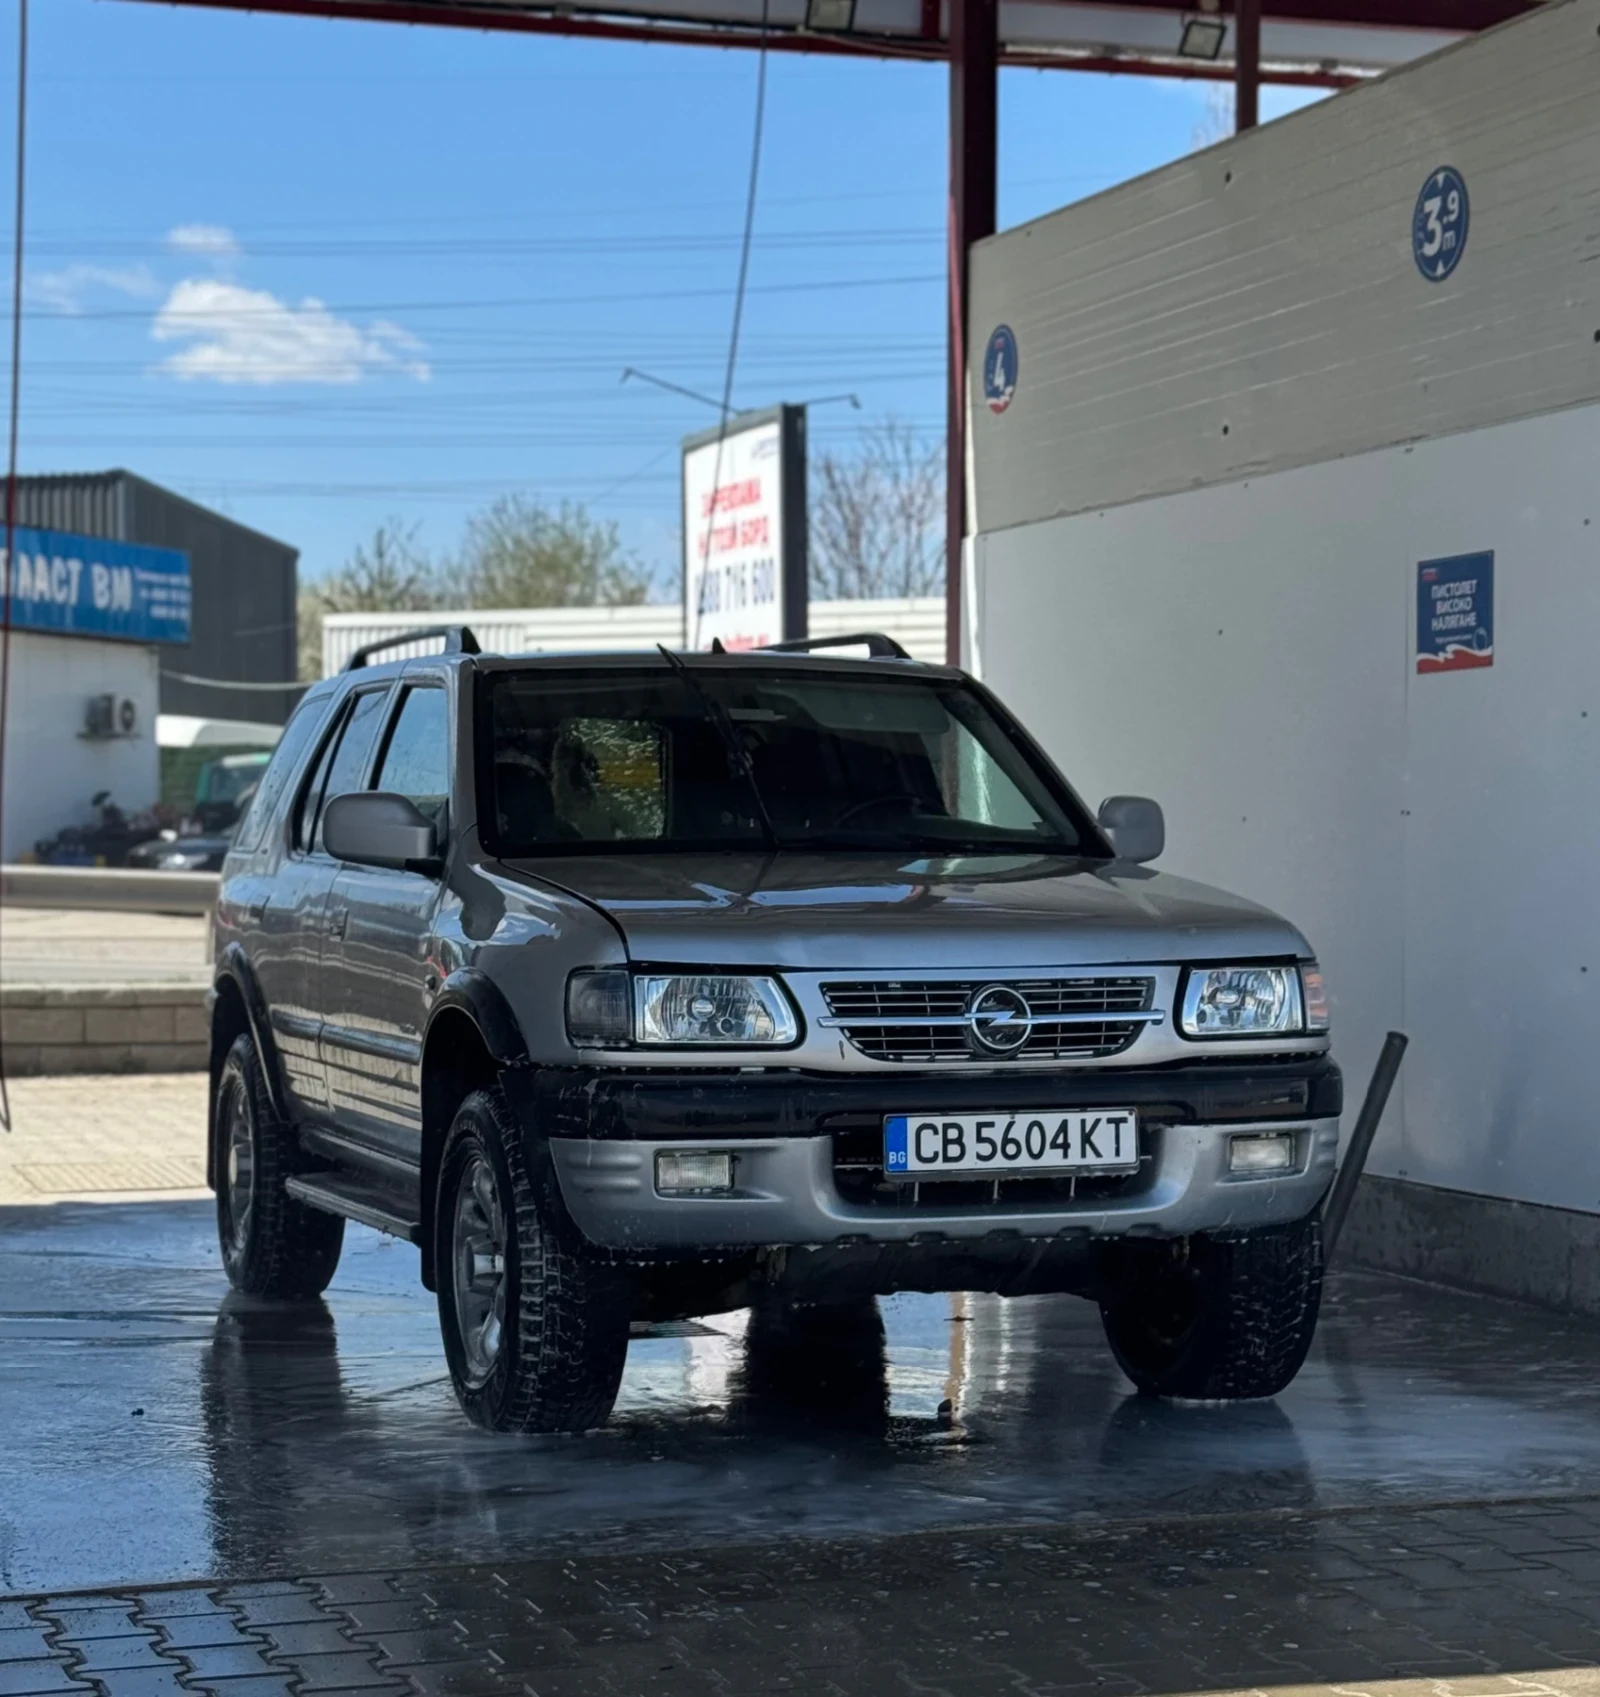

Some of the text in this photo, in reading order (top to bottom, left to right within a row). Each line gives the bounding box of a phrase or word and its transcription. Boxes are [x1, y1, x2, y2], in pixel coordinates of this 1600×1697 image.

[993, 351, 1006, 391] 4
[1436, 596, 1473, 615] ВИСОКО
[1431, 611, 1478, 631] НАЛЯГАНЕ
[888, 1150, 906, 1165] BG
